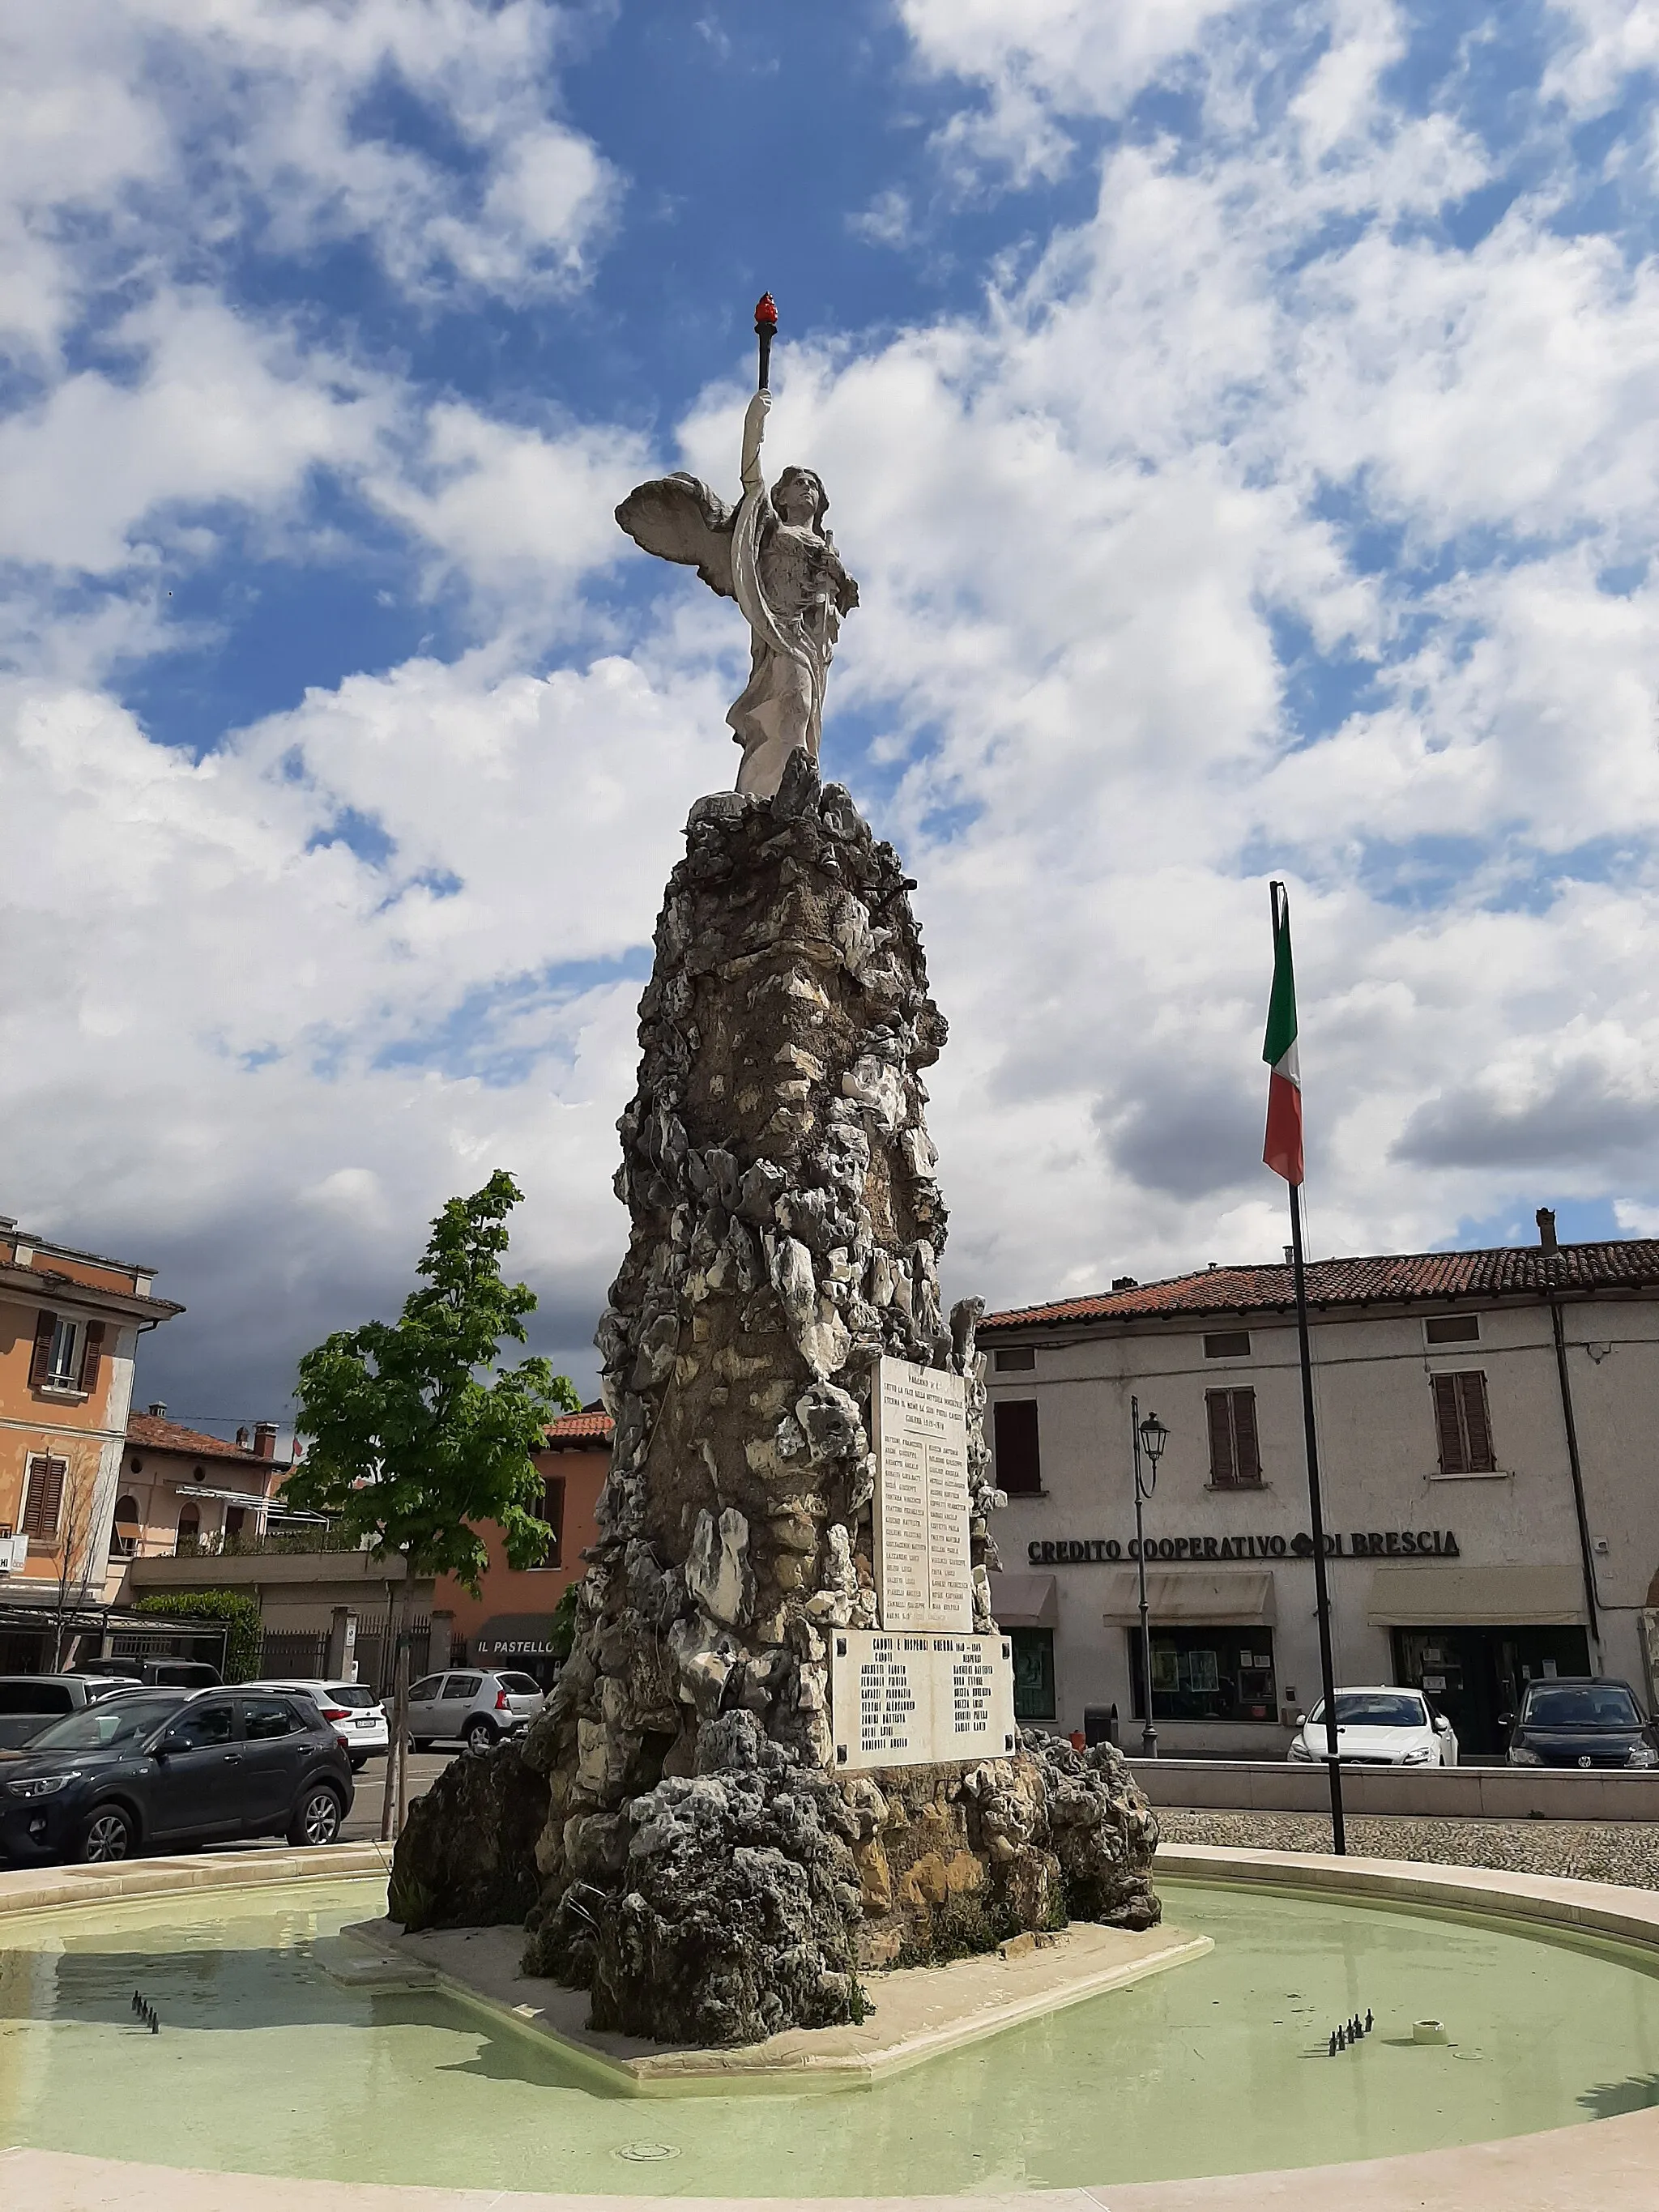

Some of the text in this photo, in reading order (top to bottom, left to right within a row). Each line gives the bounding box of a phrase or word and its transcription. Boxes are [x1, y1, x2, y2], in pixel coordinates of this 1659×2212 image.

[1028, 1530, 1460, 1562] CREDITO COOPERATIVO DI BRESCIA
[478, 1641, 555, 1653] IL PASTELLO
